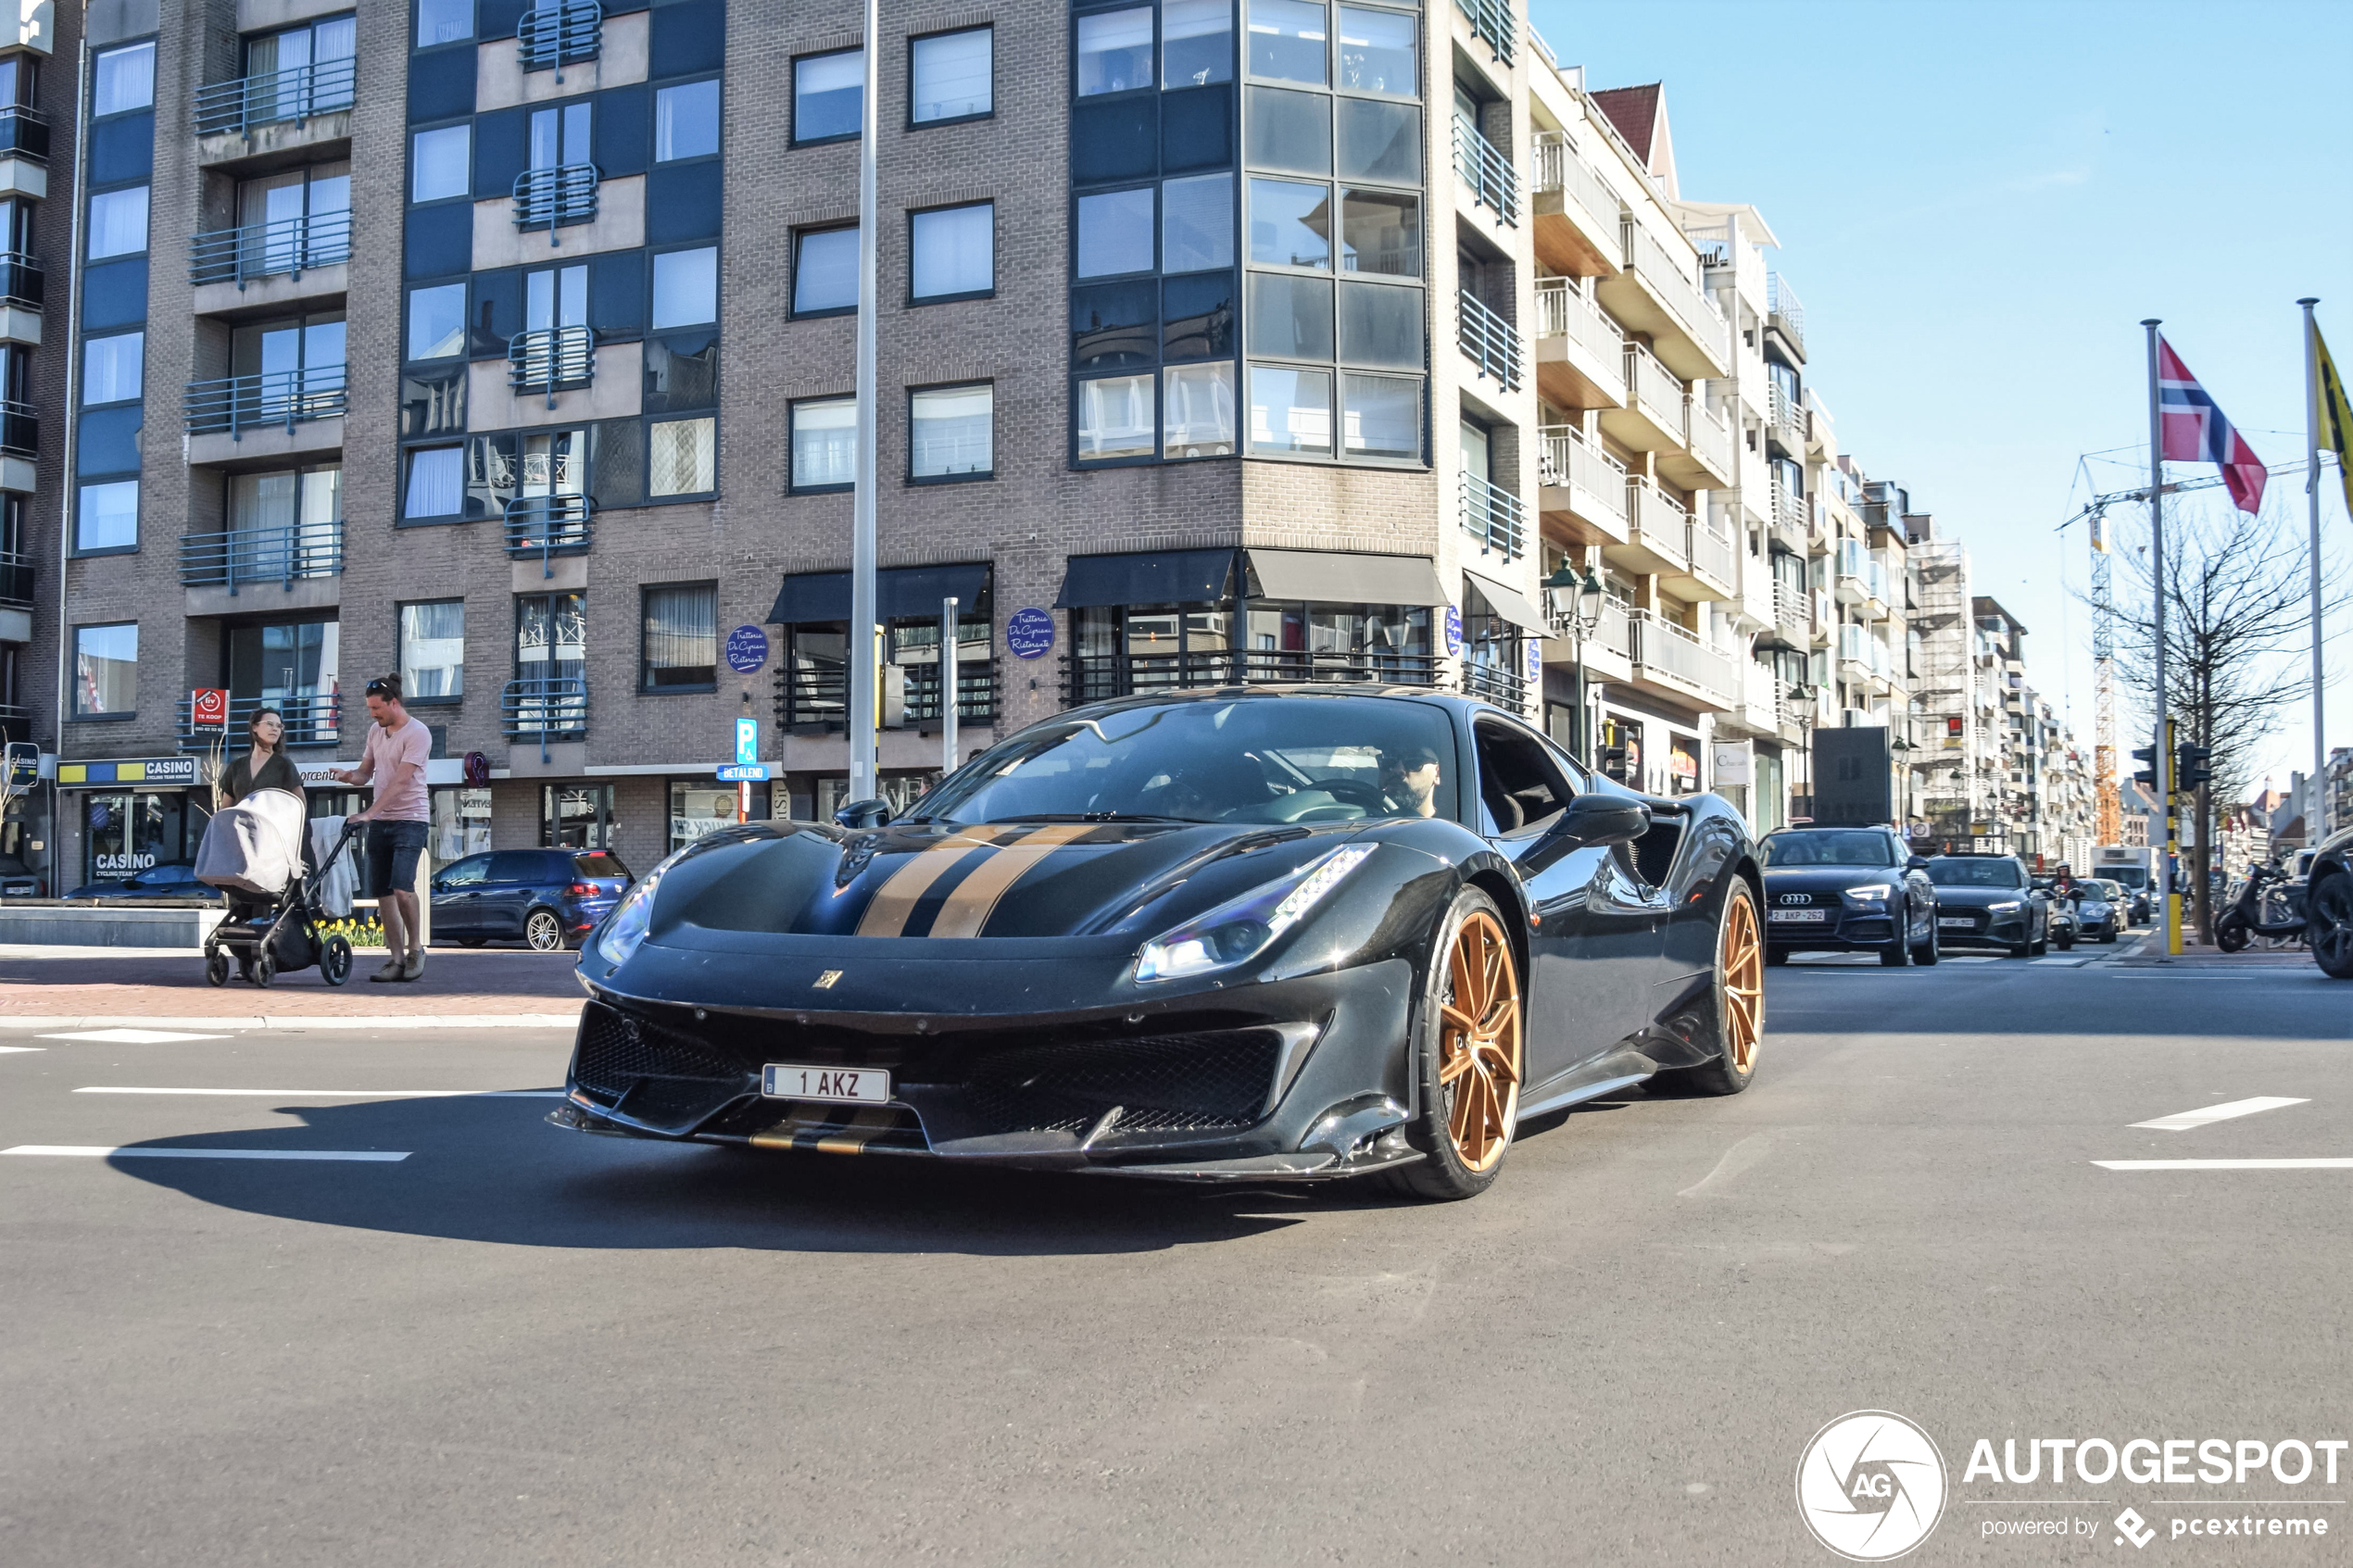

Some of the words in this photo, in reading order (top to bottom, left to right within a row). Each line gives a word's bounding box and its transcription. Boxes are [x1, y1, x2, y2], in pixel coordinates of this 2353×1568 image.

[1015, 613, 1048, 623] Trattoria
[734, 630, 763, 640] Trattoria
[1008, 625, 1021, 635] Da
[1021, 624, 1052, 639] Cipriani
[727, 641, 738, 651] Da
[738, 641, 766, 654] Cipriani
[1011, 638, 1050, 649] Ristorante
[729, 653, 763, 664] Ristorante
[738, 722, 754, 755] P
[146, 760, 193, 774] CASINO
[724, 767, 763, 778] BETALEND
[564, 803, 594, 814] LOTUS
[96, 853, 156, 869] CASINO
[766, 1083, 773, 1093] B
[799, 1071, 808, 1094] 1
[817, 1072, 860, 1097] AKZ
